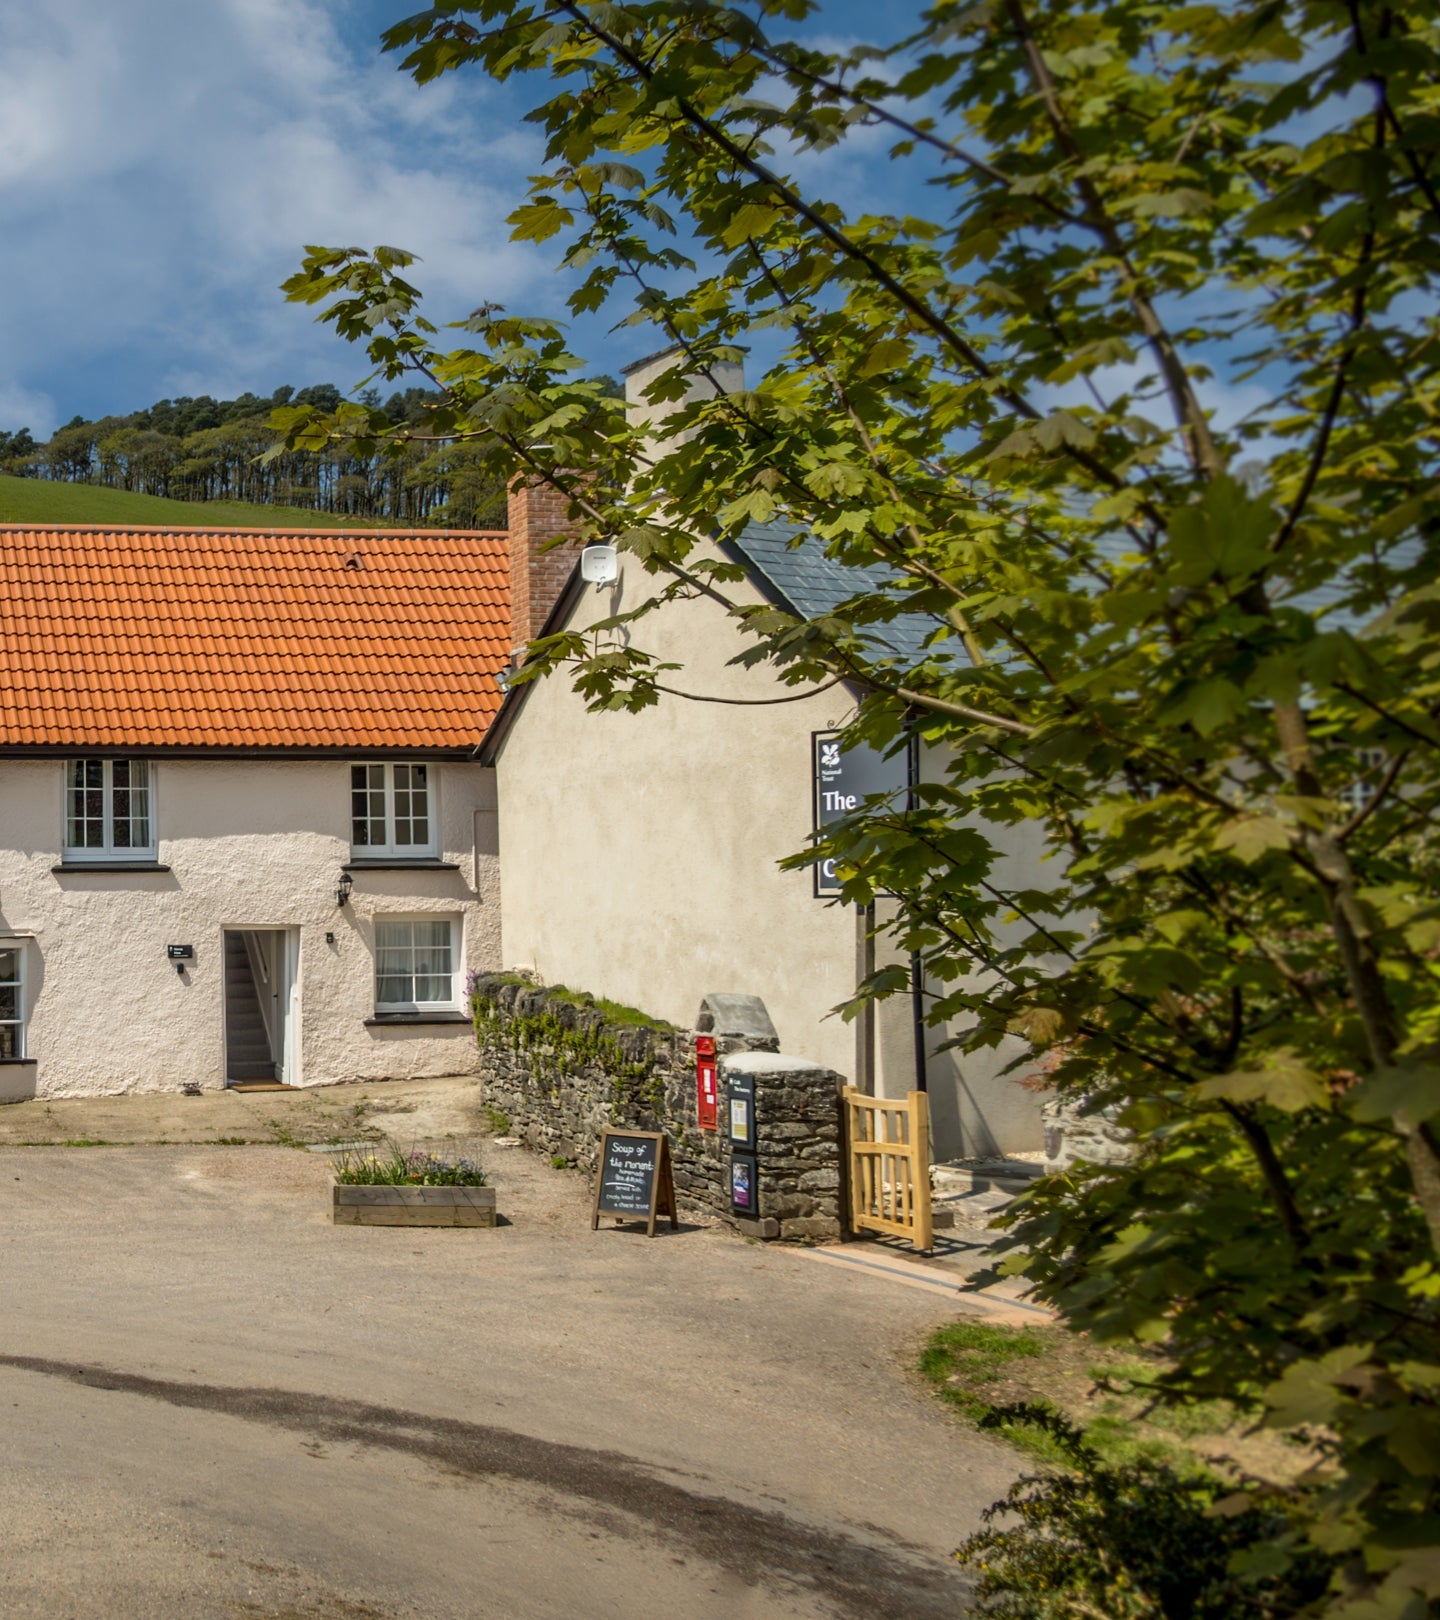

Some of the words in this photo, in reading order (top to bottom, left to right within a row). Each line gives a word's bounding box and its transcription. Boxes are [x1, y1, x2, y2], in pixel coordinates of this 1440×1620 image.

[822, 768, 842, 776] National
[822, 790, 856, 810] The
[611, 1142, 634, 1156] Soup
[636, 1144, 647, 1156] of
[609, 1156, 623, 1168] the
